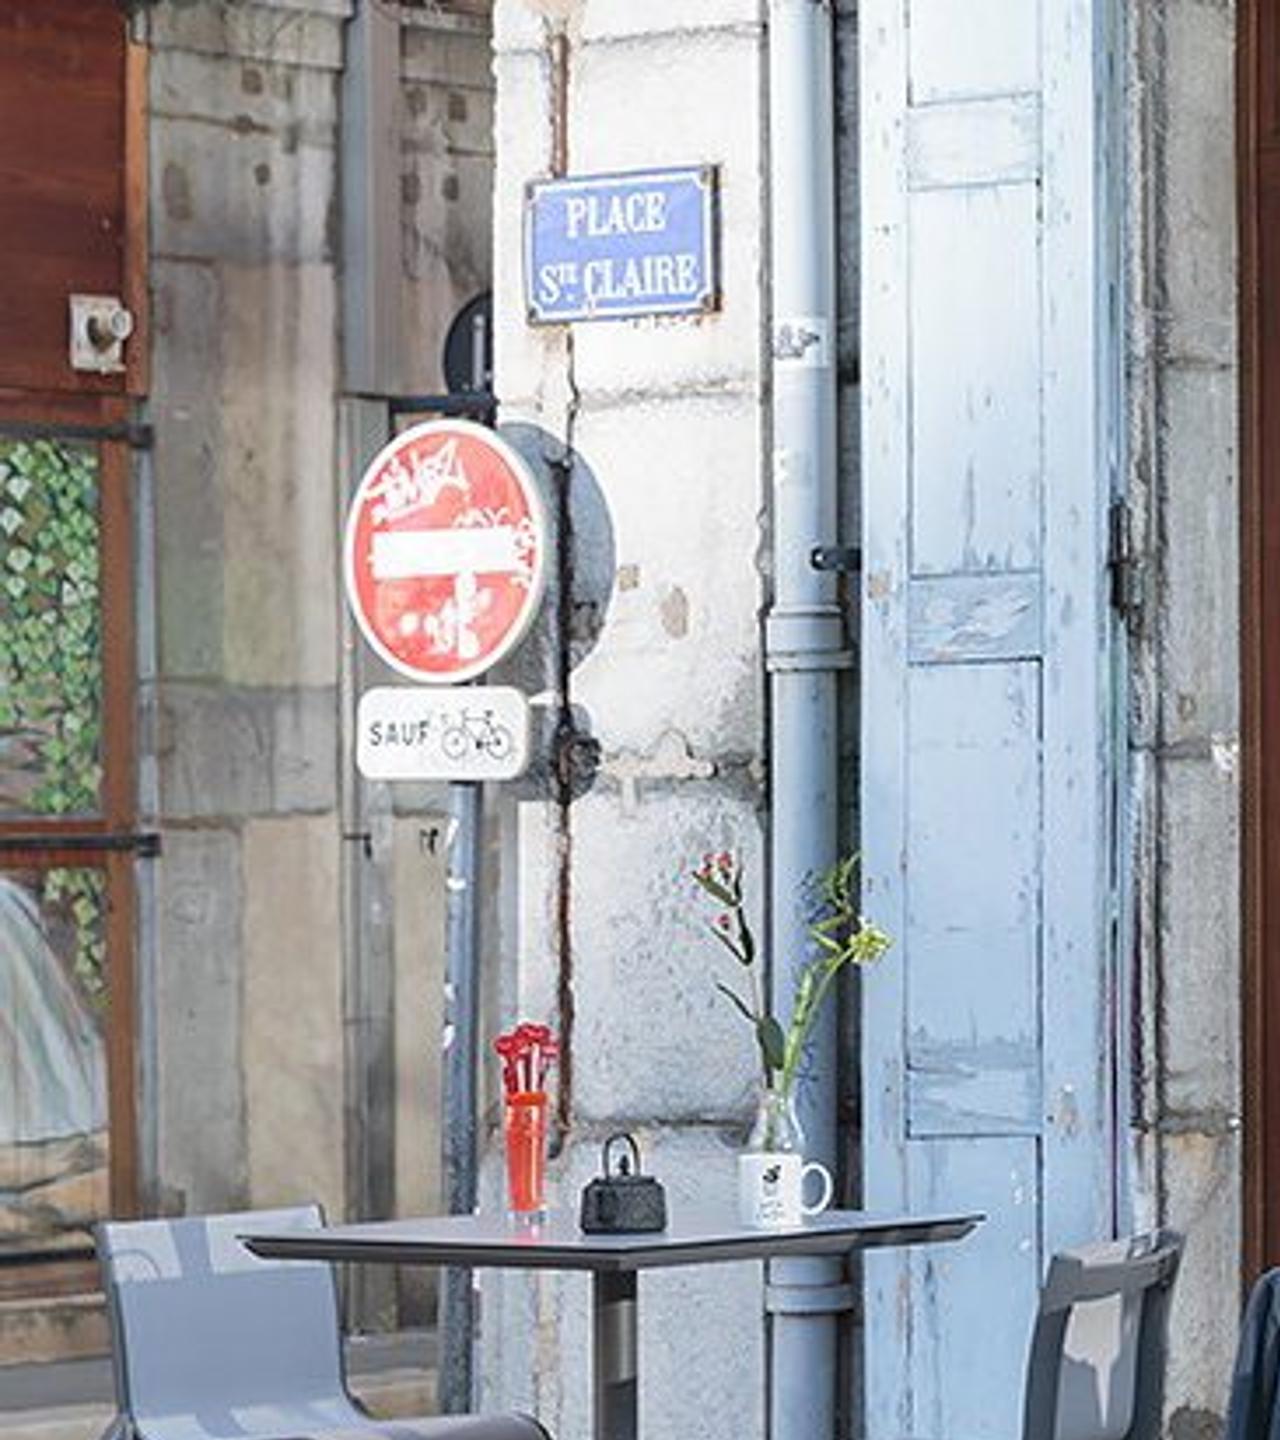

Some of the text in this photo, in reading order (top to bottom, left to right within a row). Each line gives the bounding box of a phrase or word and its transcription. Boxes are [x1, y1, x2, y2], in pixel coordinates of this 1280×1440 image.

[566, 191, 667, 239] PLACE
[584, 253, 699, 299] CLAIRE
[369, 720, 429, 747] SAUF
